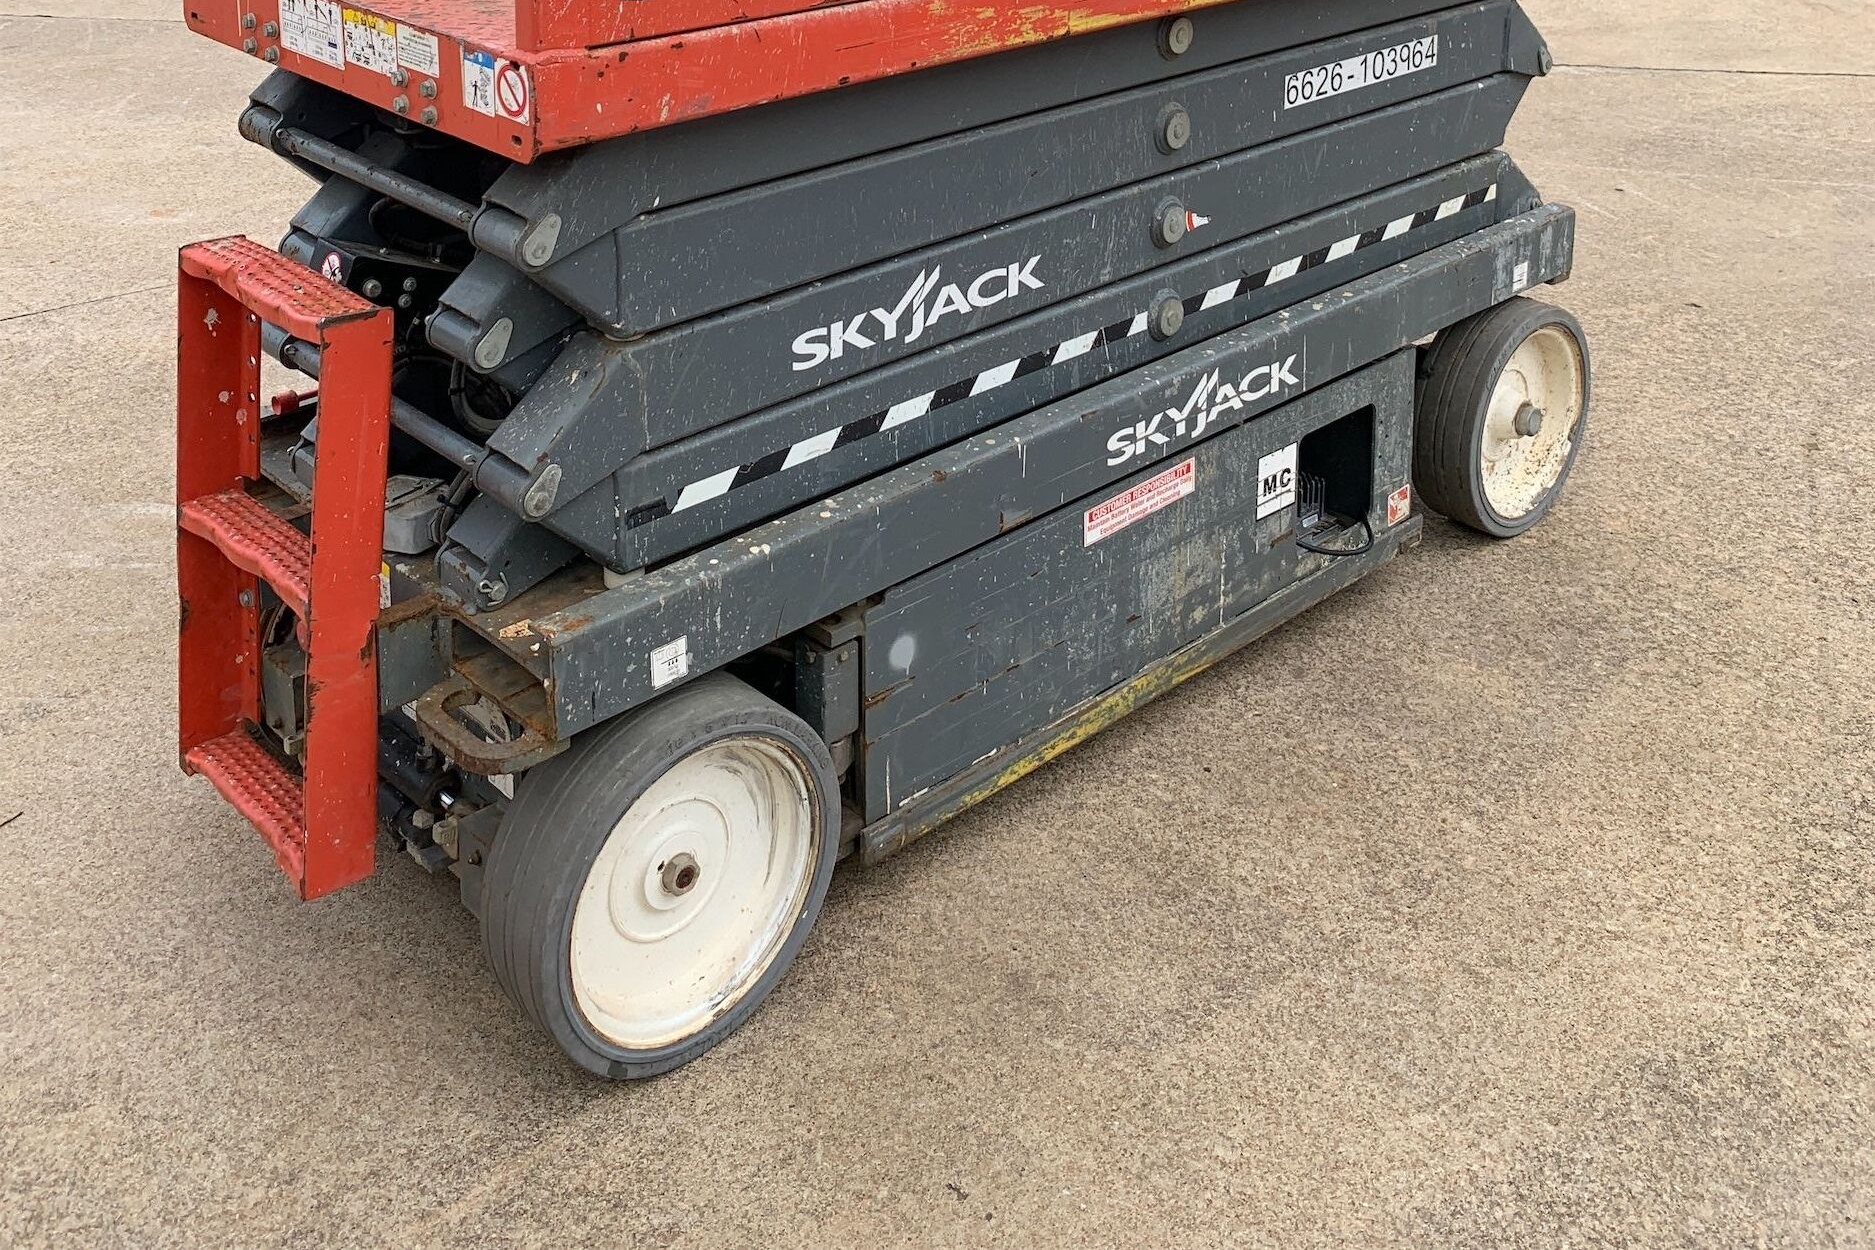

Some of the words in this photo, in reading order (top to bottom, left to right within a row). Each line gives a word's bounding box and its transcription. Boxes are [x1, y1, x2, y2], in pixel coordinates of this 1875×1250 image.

[1286, 36, 1436, 105] 6626-103964
[791, 254, 1046, 372] SKYJACK
[1106, 353, 1300, 467] SKYJACK
[1092, 493, 1132, 521] CUSTOMER
[1132, 465, 1189, 500] RESPONSIBILITY
[1110, 506, 1130, 521] Battery
[1145, 492, 1156, 503] and
[1149, 500, 1159, 511] and
